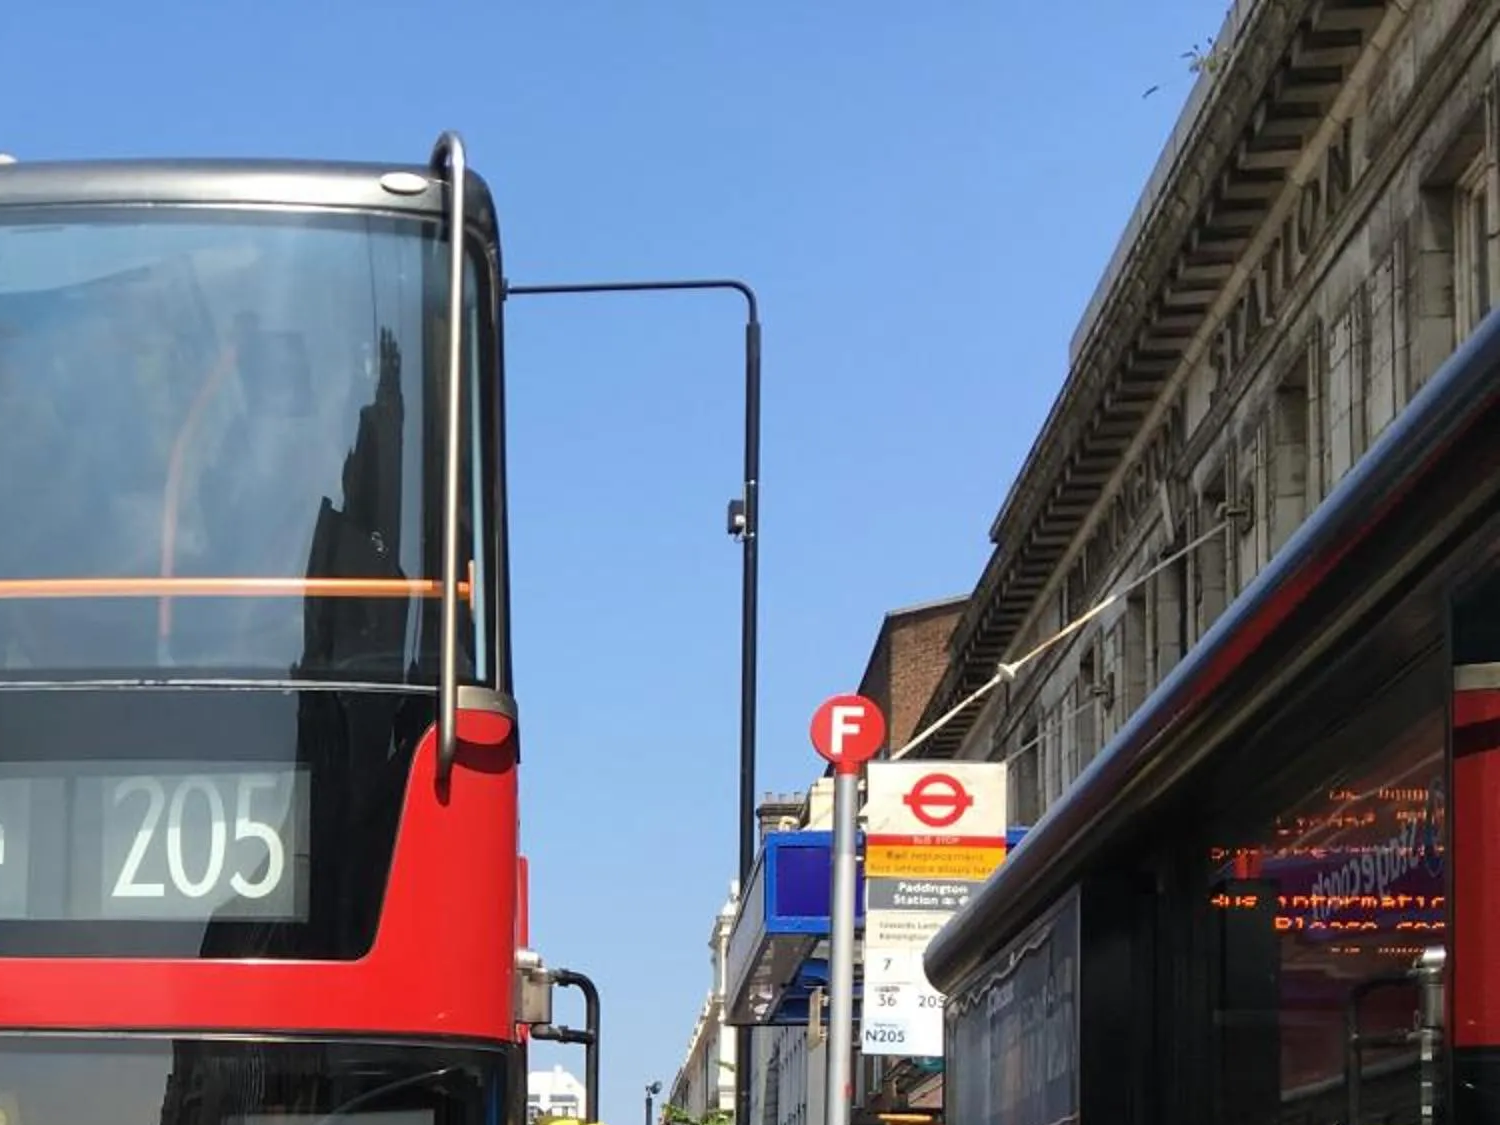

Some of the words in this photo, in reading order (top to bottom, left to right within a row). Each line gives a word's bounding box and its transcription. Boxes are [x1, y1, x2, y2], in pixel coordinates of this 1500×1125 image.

[831, 705, 865, 754] F
[112, 775, 285, 898] 205
[898, 882, 969, 895] Paddington
[893, 894, 938, 905] Station
[883, 957, 893, 972] 7
[877, 993, 898, 1007] 36
[865, 1029, 906, 1043] N205
